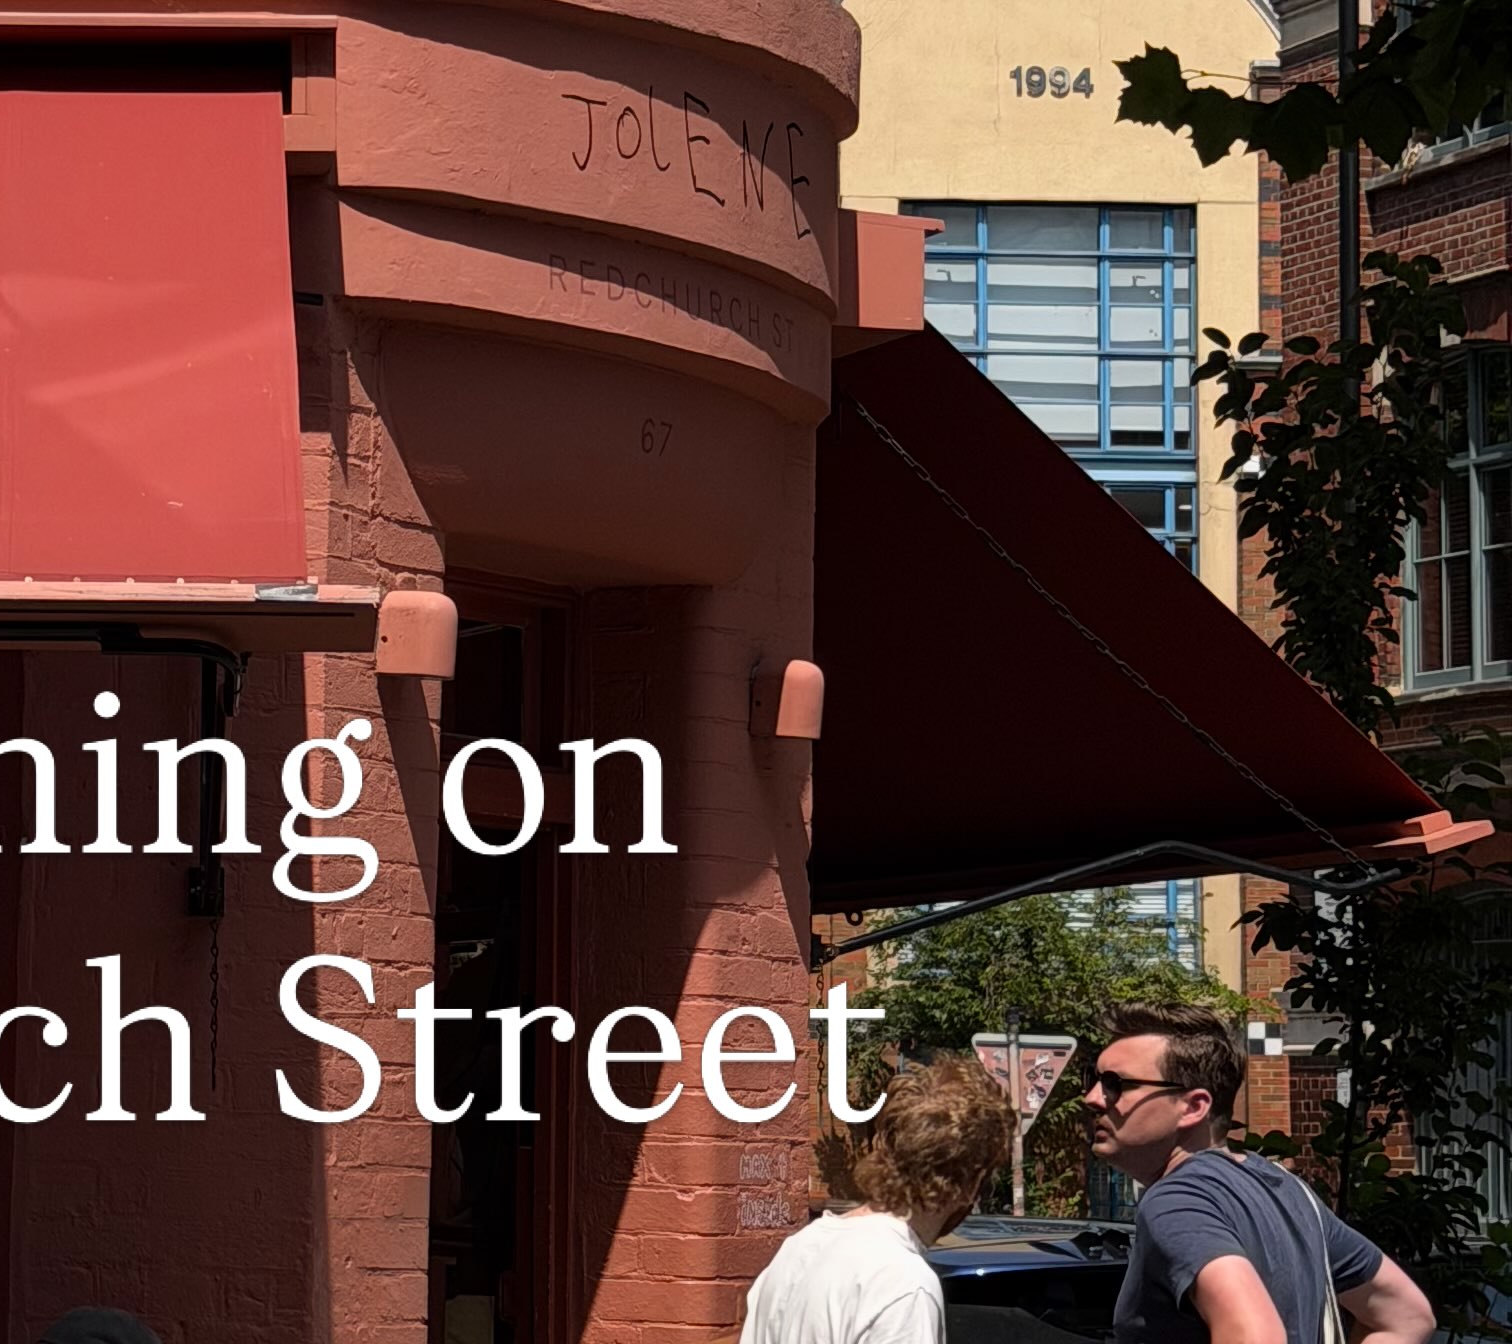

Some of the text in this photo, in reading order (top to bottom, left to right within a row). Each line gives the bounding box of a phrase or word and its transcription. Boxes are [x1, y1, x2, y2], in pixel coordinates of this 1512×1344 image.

[1009, 64, 1095, 99] 1994
[561, 84, 812, 240] JOLENE
[548, 253, 761, 341] REDCHURCH
[641, 417, 673, 457] 67
